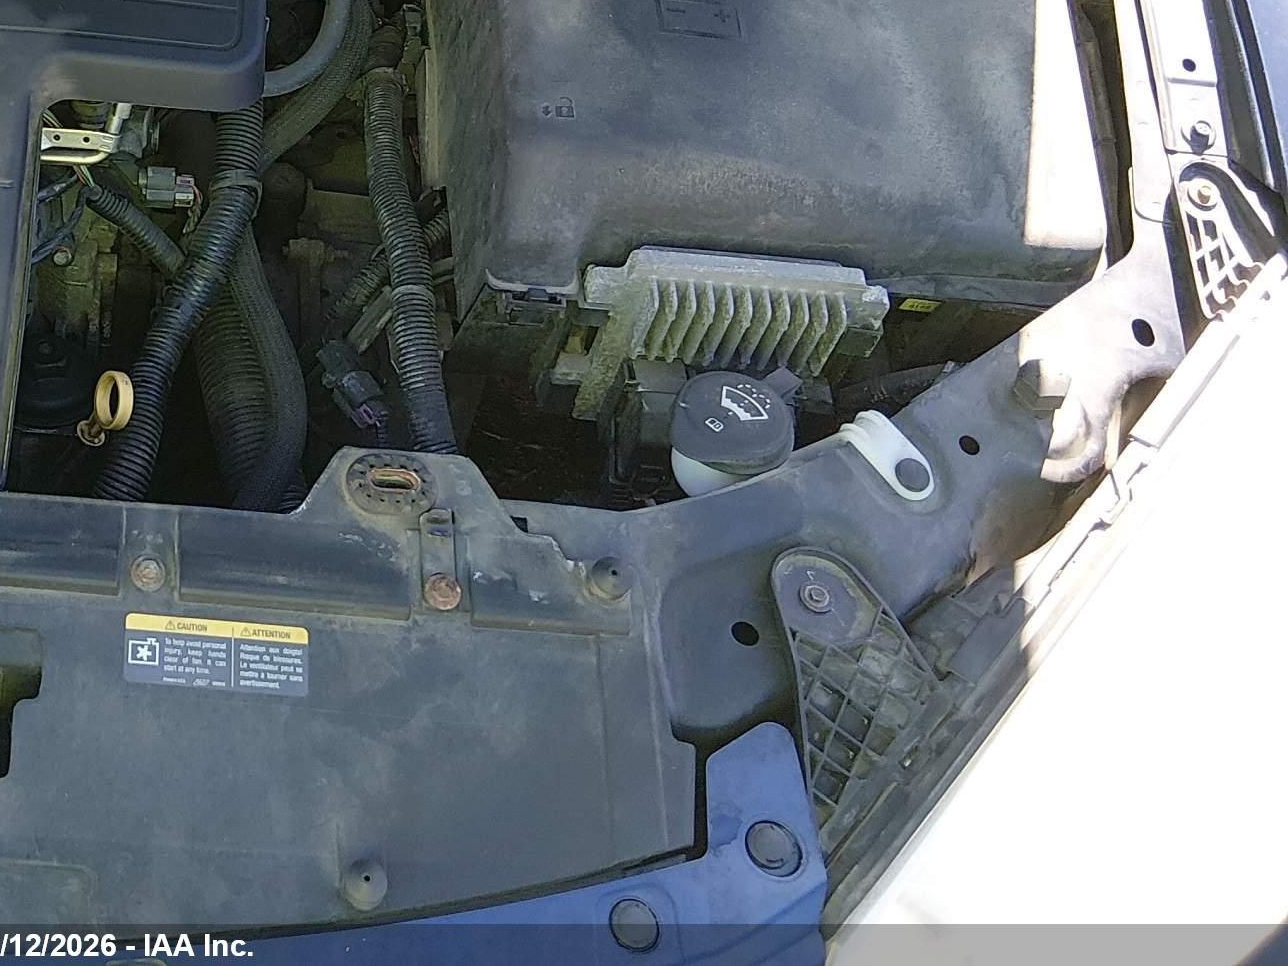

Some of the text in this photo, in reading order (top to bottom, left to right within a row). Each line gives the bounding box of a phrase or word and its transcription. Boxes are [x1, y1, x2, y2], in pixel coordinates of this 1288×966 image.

[177, 622, 208, 632] CAUTION
[251, 629, 291, 640] ATTENTION
[202, 641, 227, 650] personal
[187, 648, 203, 657] keep
[207, 650, 227, 659] hands
